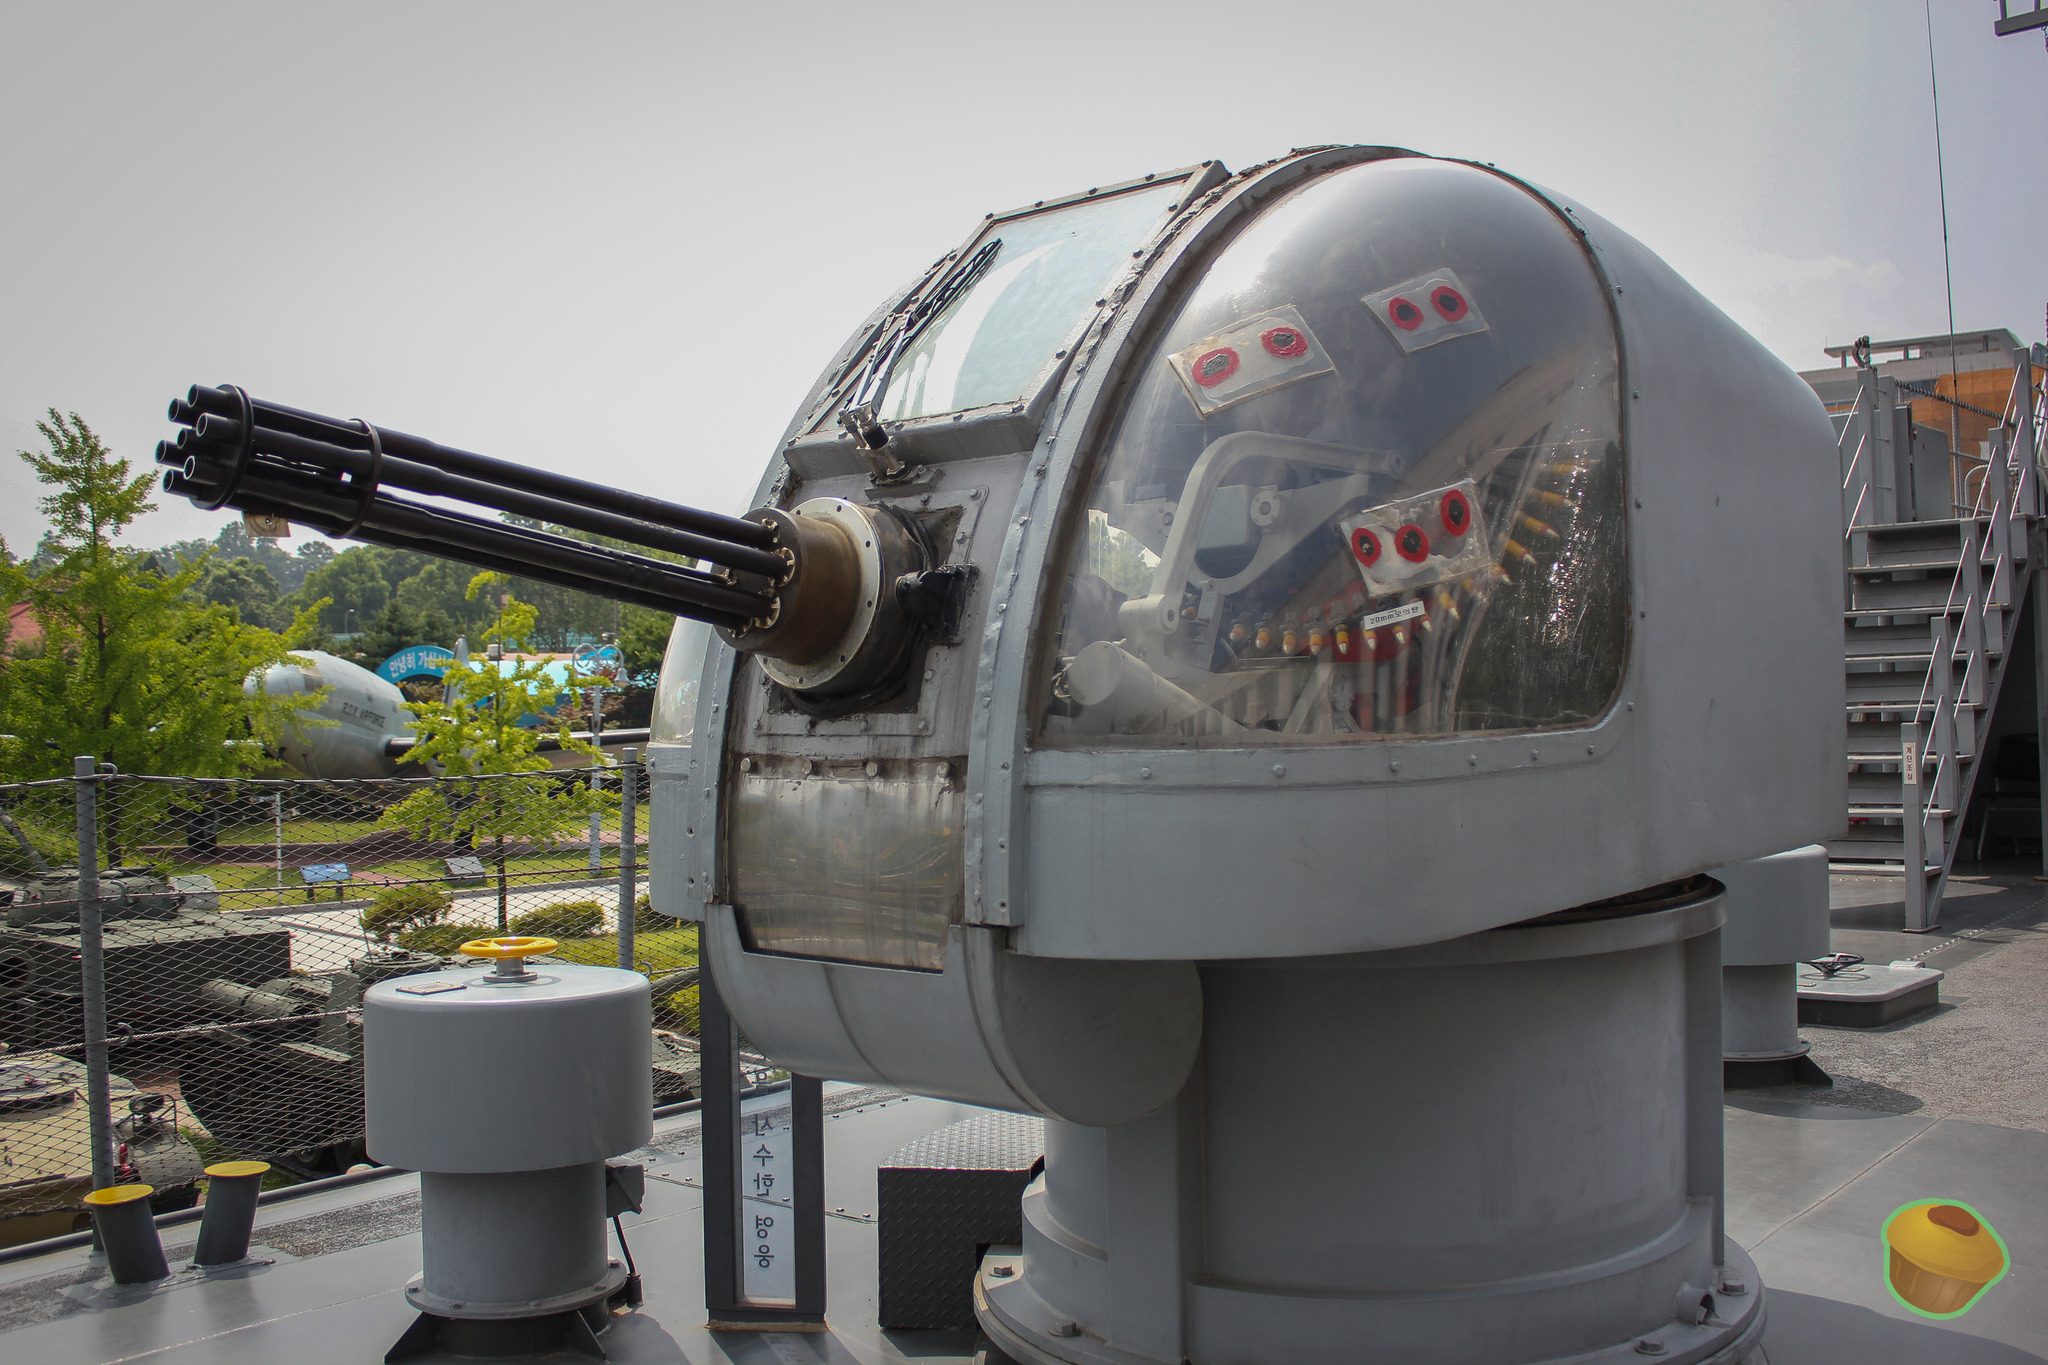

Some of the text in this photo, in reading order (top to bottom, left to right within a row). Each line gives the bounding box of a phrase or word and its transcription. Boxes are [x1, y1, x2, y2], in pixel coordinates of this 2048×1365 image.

[1370, 606, 1419, 624] 20mm모의탄
[389, 652, 416, 678] 안녕히
[1905, 746, 1913, 781] 계단조심
